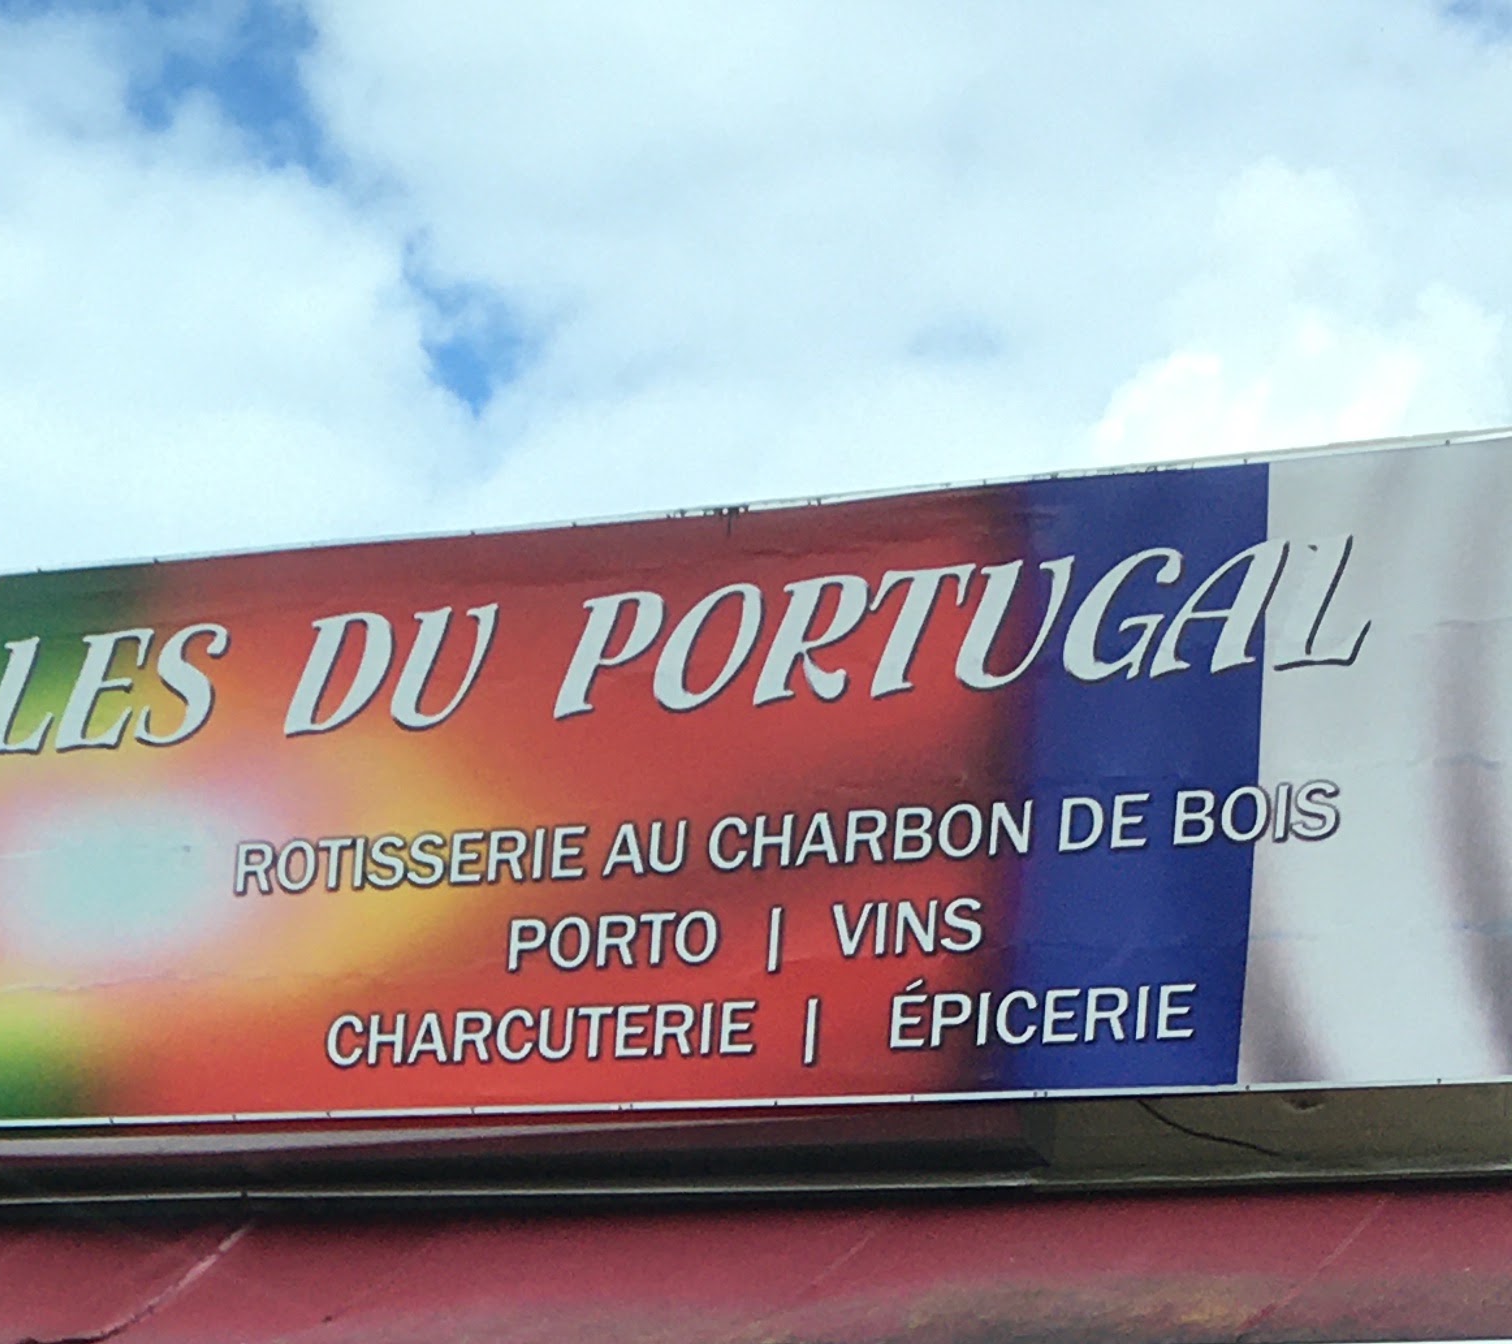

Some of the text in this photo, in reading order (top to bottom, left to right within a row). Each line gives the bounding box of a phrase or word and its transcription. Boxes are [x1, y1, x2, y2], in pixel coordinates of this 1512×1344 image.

[284, 602, 500, 737] DU
[553, 535, 1372, 721] PORTUGAL
[234, 778, 1341, 895] ROTISSERIE AU CHARBON DE BOIS
[507, 896, 984, 972] PORTO VINS
[326, 978, 1198, 1068] CHARCUTERIE ÉPICERIE
